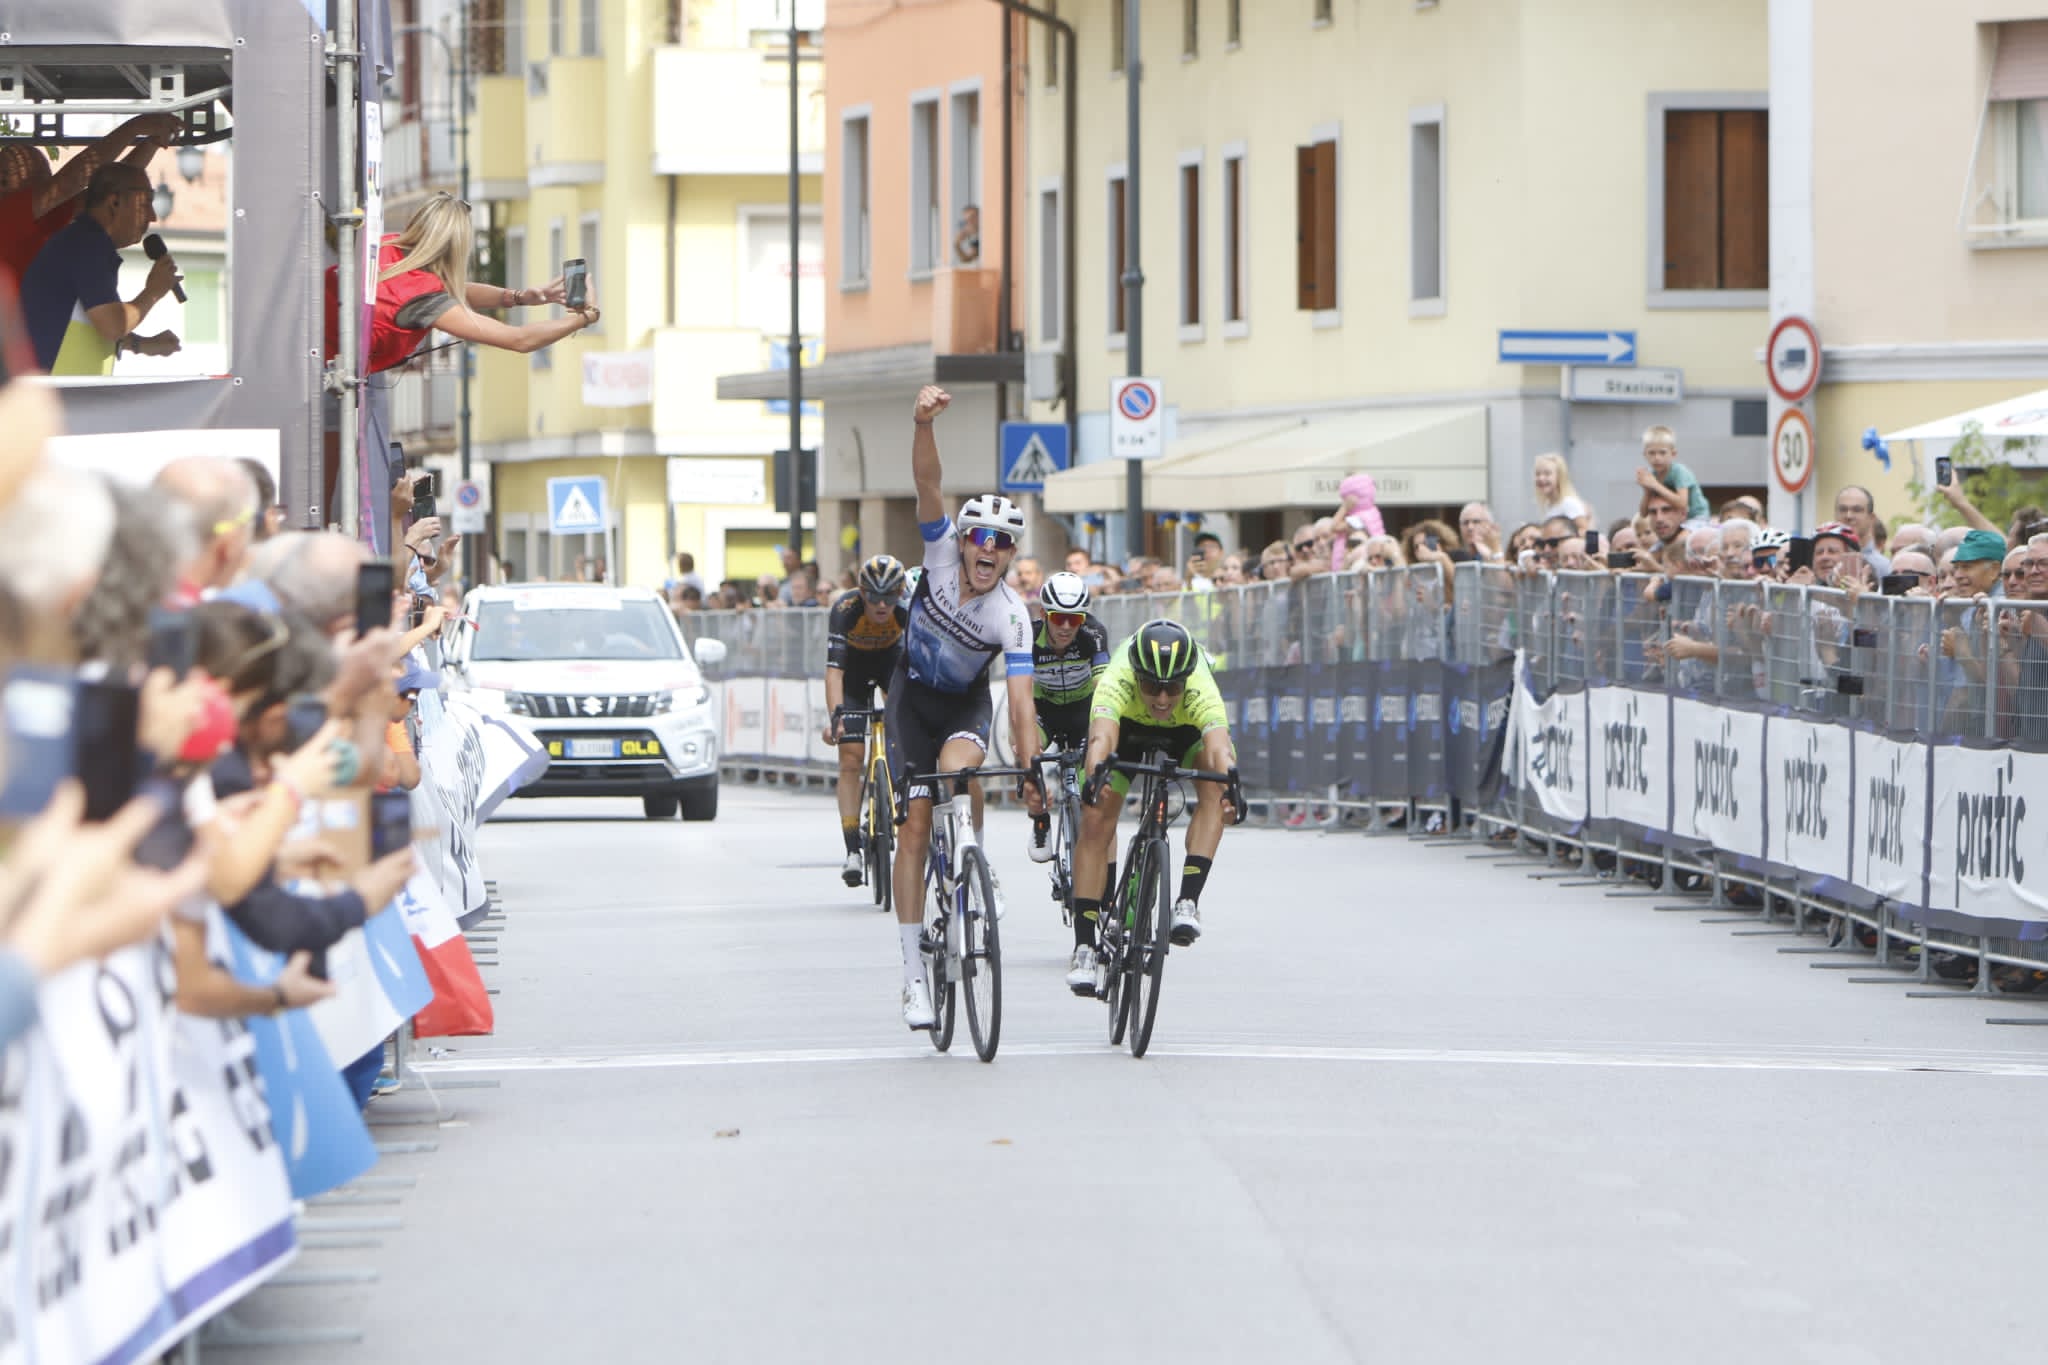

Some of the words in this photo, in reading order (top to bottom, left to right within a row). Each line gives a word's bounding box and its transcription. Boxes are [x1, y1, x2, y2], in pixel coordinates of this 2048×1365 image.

[1782, 431, 1803, 470] 30
[935, 584, 985, 635] Trevgiani
[1604, 695, 1649, 816] pratic
[1693, 713, 1739, 835] pratic
[1784, 727, 1828, 862] pratic
[1866, 746, 1906, 887] pratic
[1955, 753, 2027, 909] pratic
